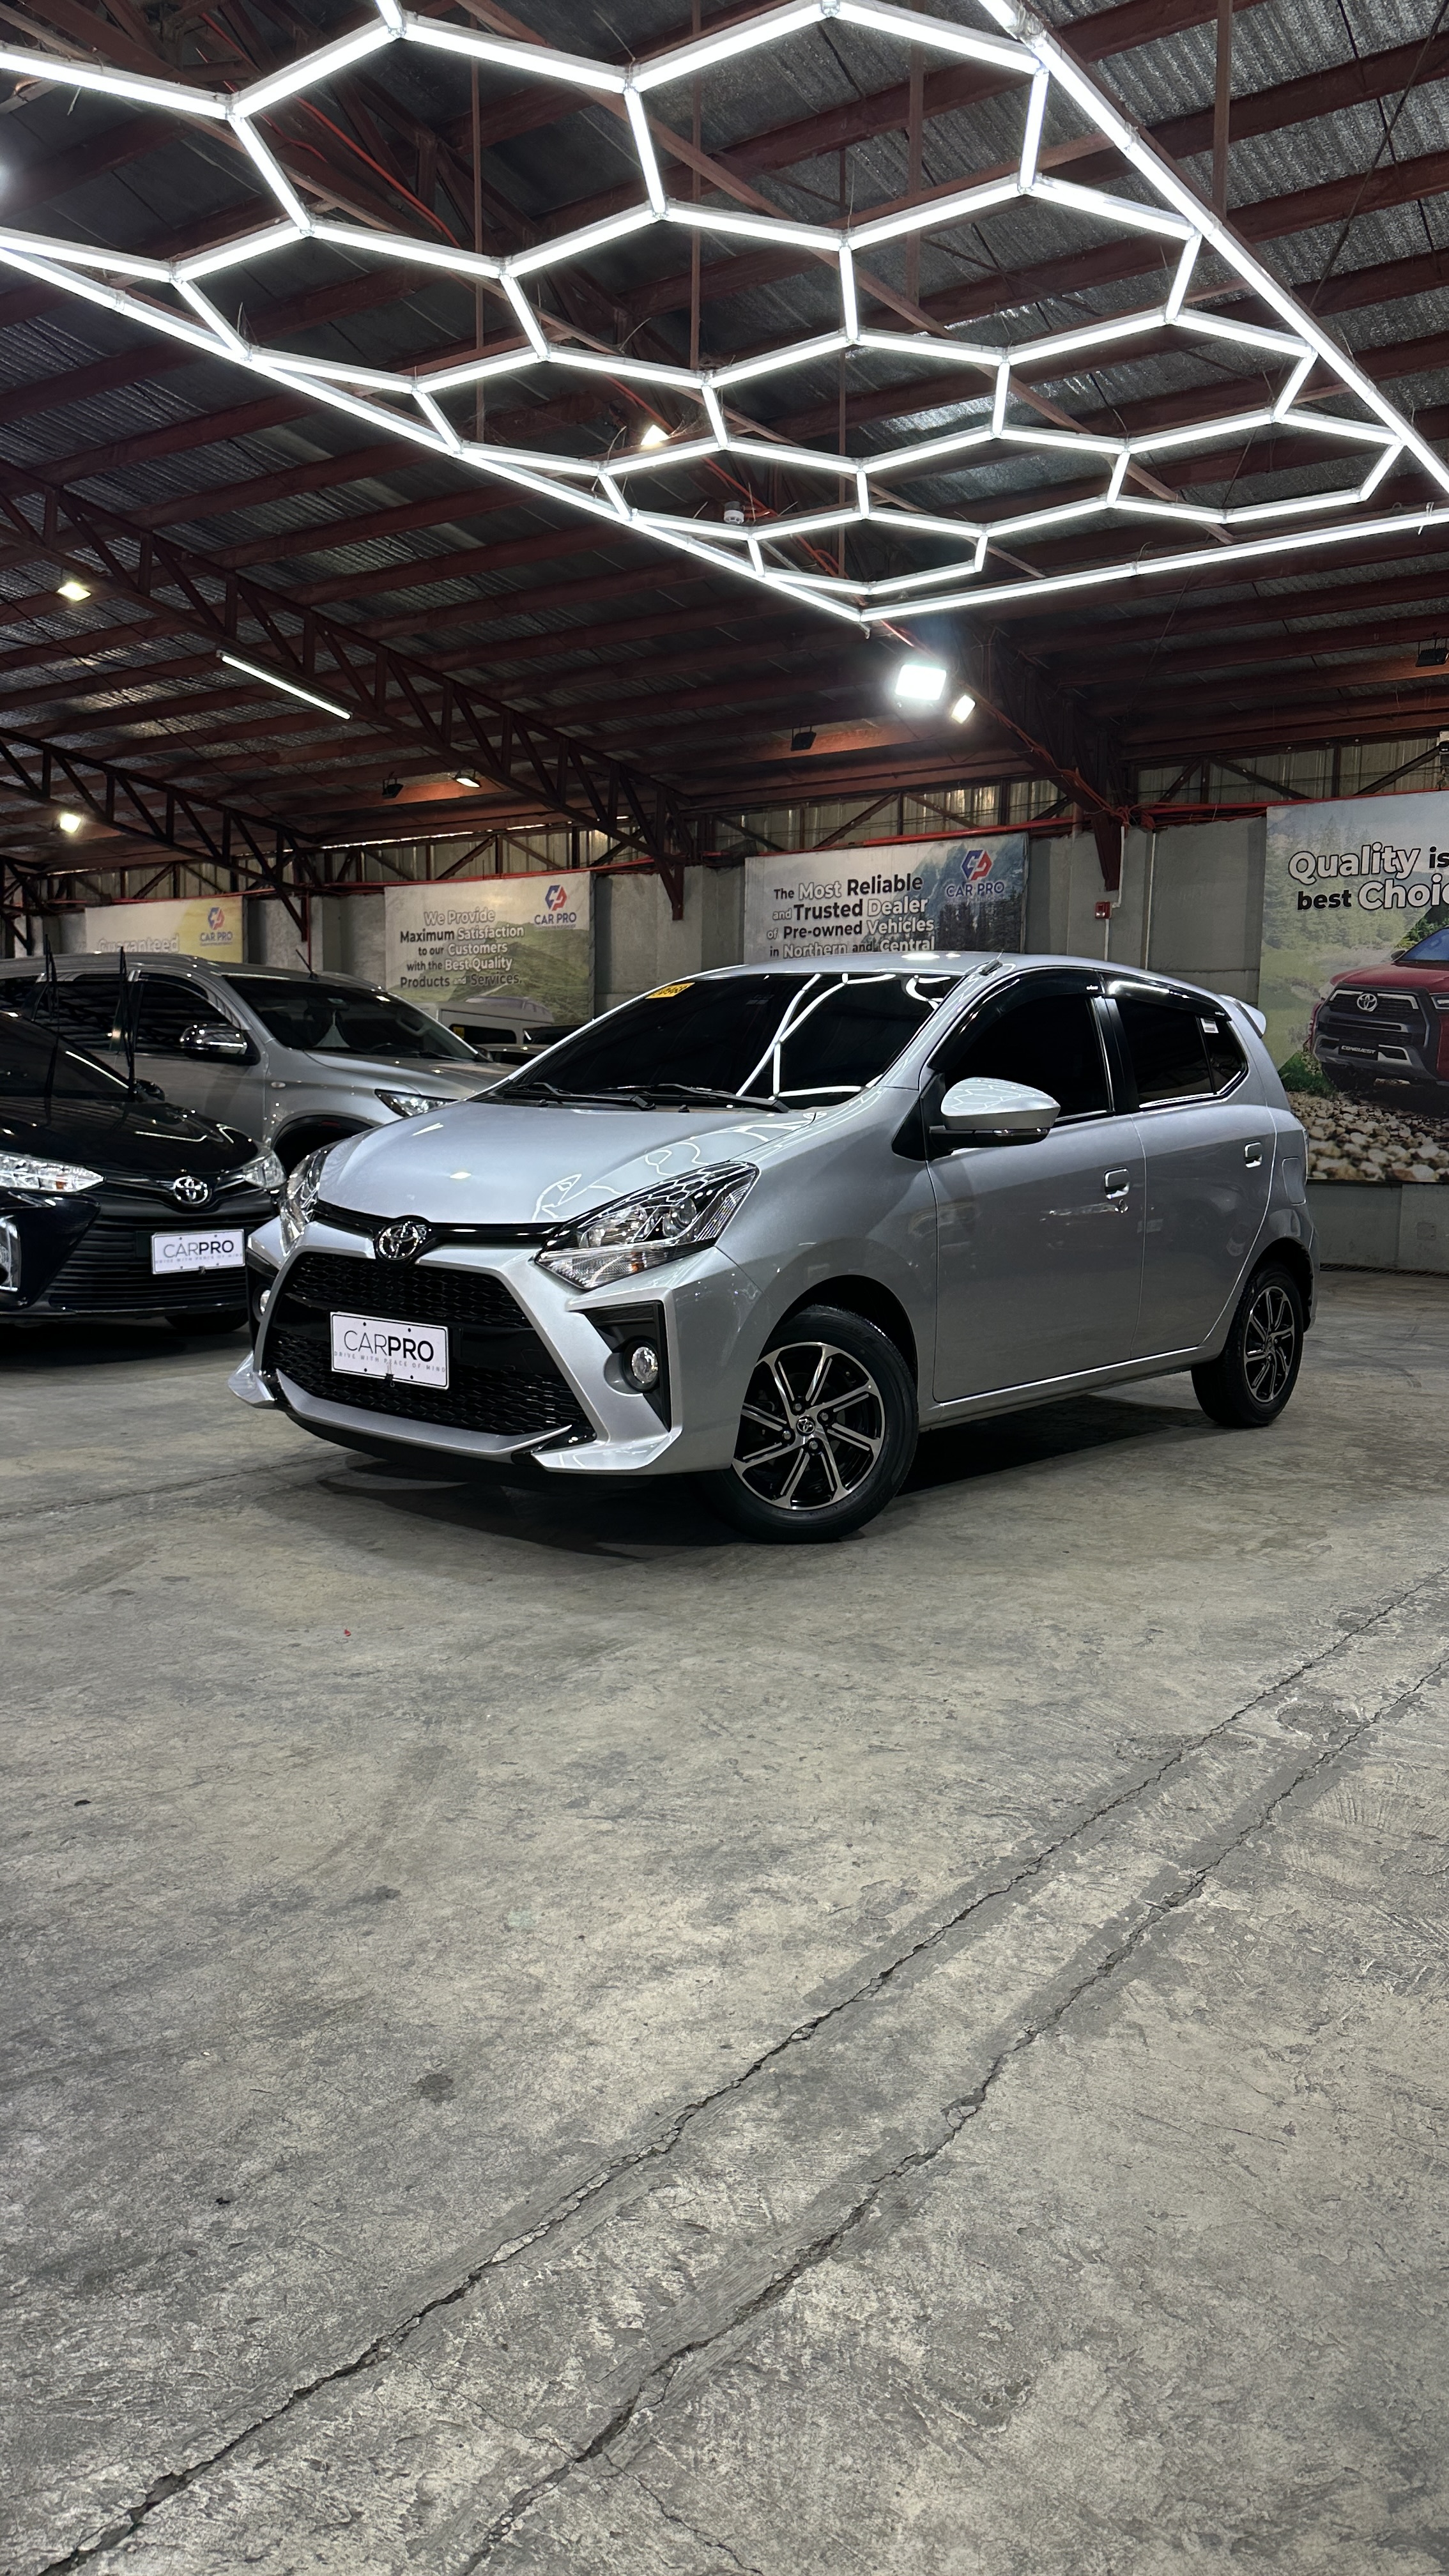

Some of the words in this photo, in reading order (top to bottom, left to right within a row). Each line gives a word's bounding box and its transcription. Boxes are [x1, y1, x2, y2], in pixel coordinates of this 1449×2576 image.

[1288, 841, 1421, 885] Quality
[1429, 846, 1449, 869] is
[774, 887, 795, 900] The
[799, 880, 841, 900] Most
[847, 873, 923, 896] Reliable
[946, 884, 973, 898] CAR
[977, 881, 1005, 895] PRO
[772, 908, 792, 921] and
[793, 898, 862, 921] Trusted
[867, 896, 928, 917] Dealer
[1297, 889, 1352, 910] best
[424, 910, 445, 926] We
[448, 907, 496, 924] Provide
[534, 914, 554, 925] CAR
[556, 912, 577, 923] PRO
[200, 932, 215, 942] CAR
[217, 931, 233, 941] PRO
[400, 928, 454, 943] Maximum
[457, 924, 525, 940] Satisfaction
[767, 928, 778, 940] of
[783, 921, 862, 939] Pre-owned
[866, 917, 935, 935] Vehicles
[97, 932, 180, 953] Guaranteed
[418, 947, 427, 956] to
[429, 947, 444, 956] our
[448, 942, 508, 956] Customers
[769, 946, 779, 957] in
[783, 942, 847, 958] Northern
[852, 940, 872, 952] and
[880, 935, 935, 952] Central
[407, 960, 426, 971] with
[428, 960, 443, 970] the
[445, 958, 470, 971] Best
[471, 956, 513, 972] Quality
[401, 975, 450, 988] Products
[454, 976, 467, 985] and
[470, 972, 523, 986] Services.
[163, 1240, 234, 1258] CARPRO
[344, 1330, 434, 1362] CARPRO
[334, 1351, 356, 1360] DRIVE
[384, 1358, 407, 1367] PEACE
[426, 1365, 445, 1373] MIND
